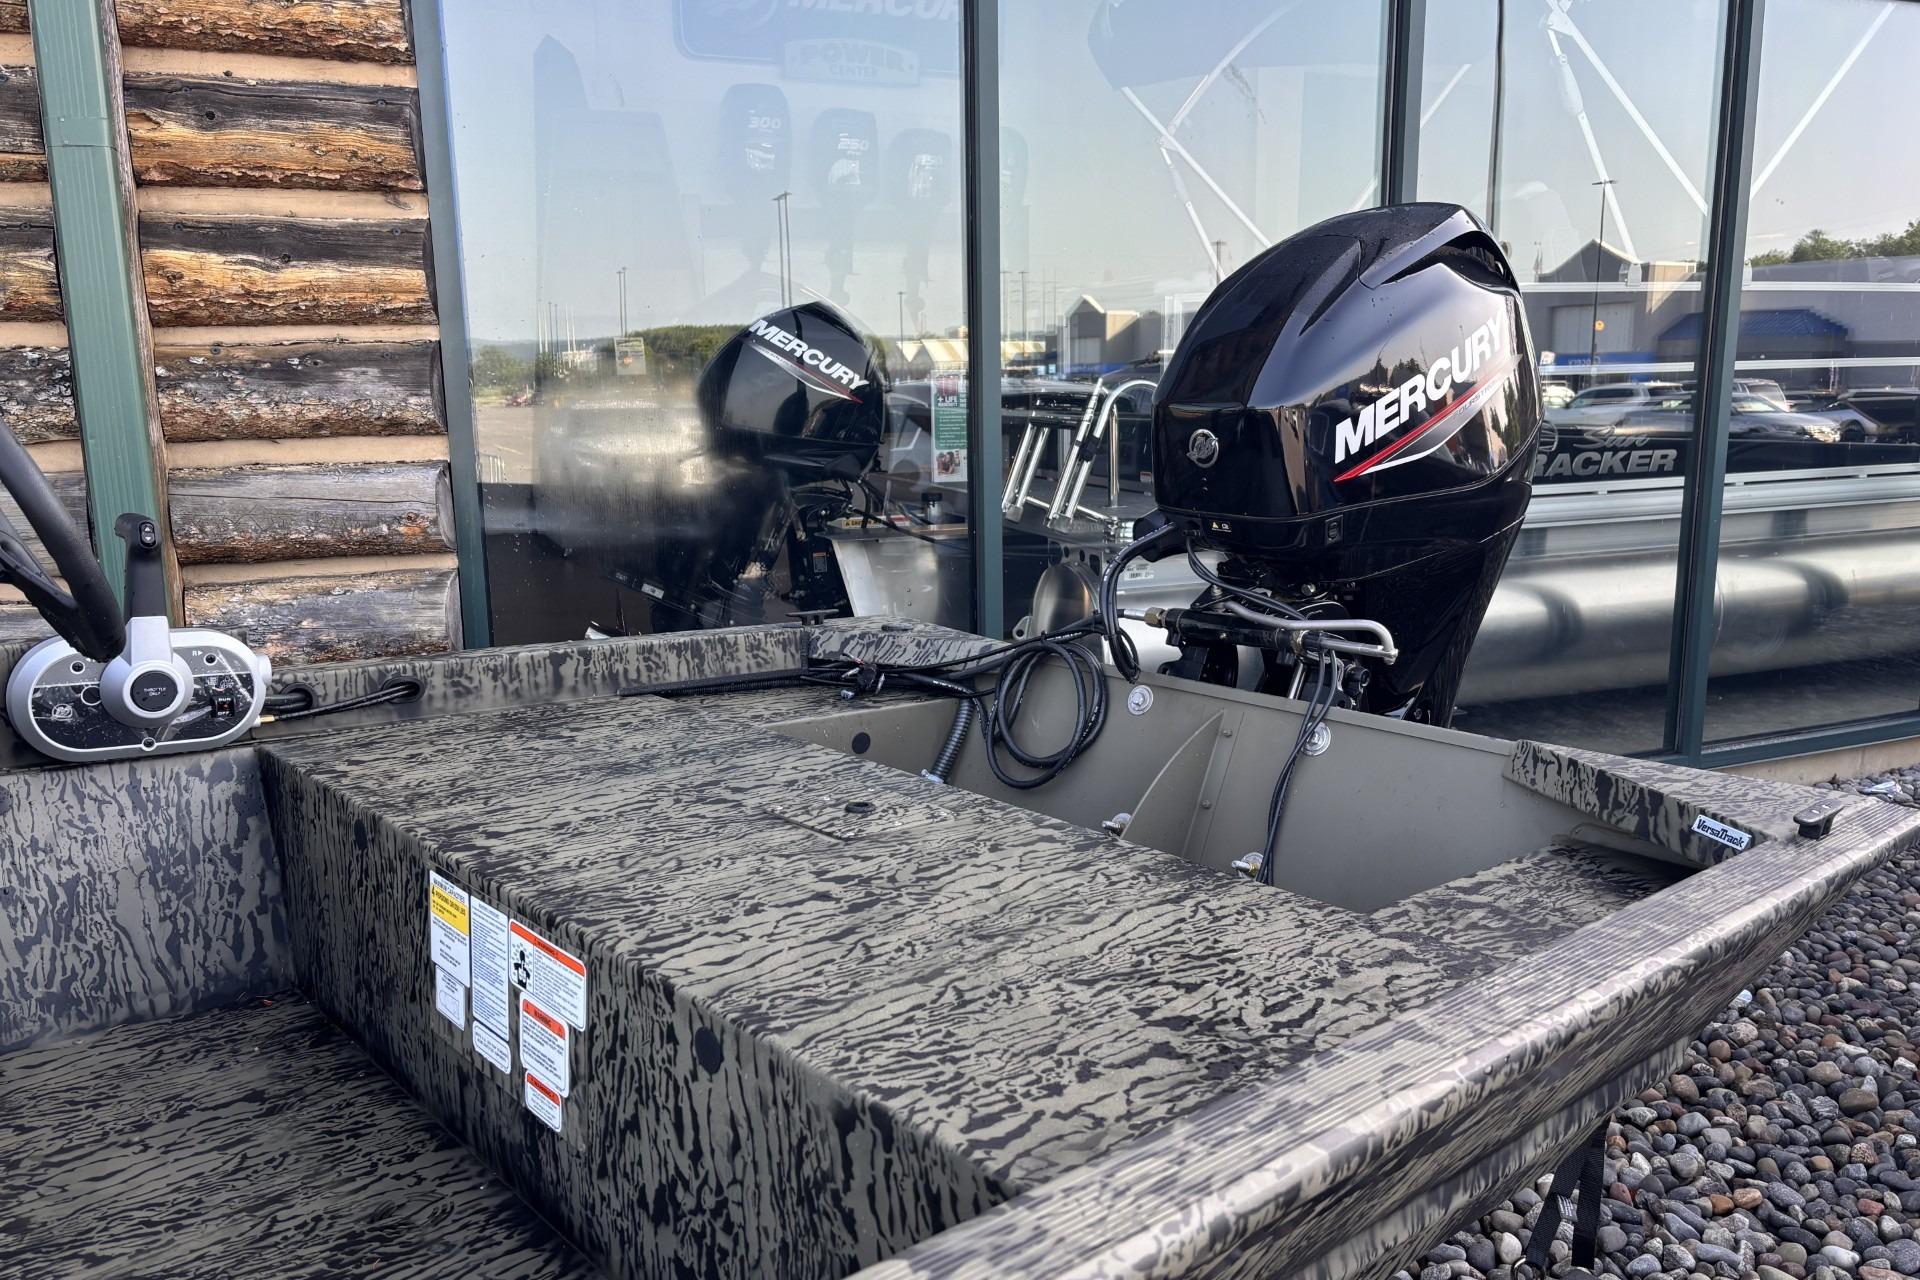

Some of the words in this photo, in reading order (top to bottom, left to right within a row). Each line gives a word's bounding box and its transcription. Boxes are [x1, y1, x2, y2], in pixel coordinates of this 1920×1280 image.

[829, 64, 880, 79] CENTER
[747, 117, 782, 129] 300
[837, 137, 869, 150] 250
[749, 319, 870, 390] MERCURY
[1335, 310, 1506, 464] MERCURY
[1573, 425, 1650, 447] Sun
[1534, 449, 1677, 478] RACKER
[1697, 818, 1744, 848] VersaTrack
